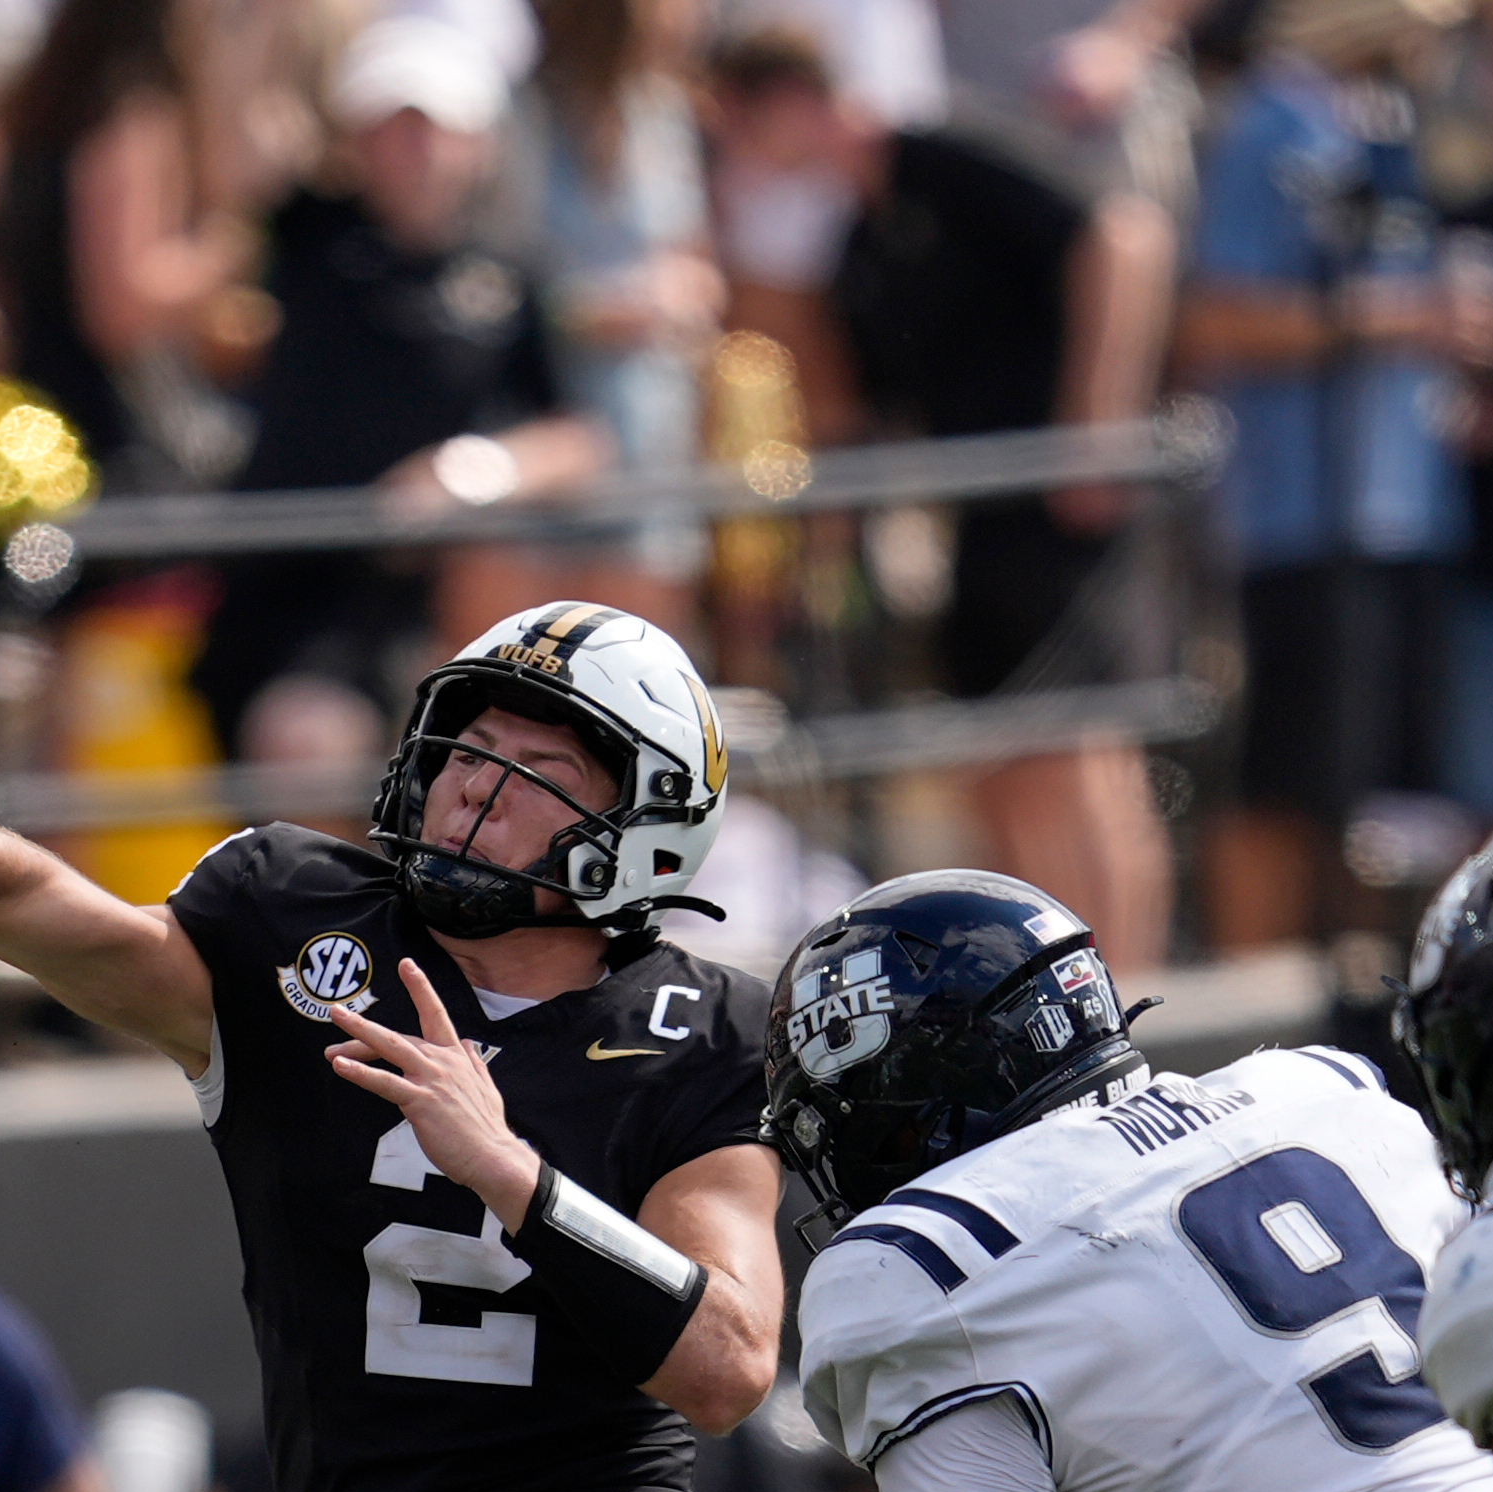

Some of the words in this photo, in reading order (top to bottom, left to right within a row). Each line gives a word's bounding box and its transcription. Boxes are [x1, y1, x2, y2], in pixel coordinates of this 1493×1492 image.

[498, 643, 563, 675] VUFB
[302, 937, 367, 999] SEC
[285, 982, 358, 1020] GRADUE
[649, 984, 701, 1041] C
[786, 975, 896, 1054] STATE
[363, 1116, 537, 1387] 2
[1169, 1141, 1460, 1456] 9
